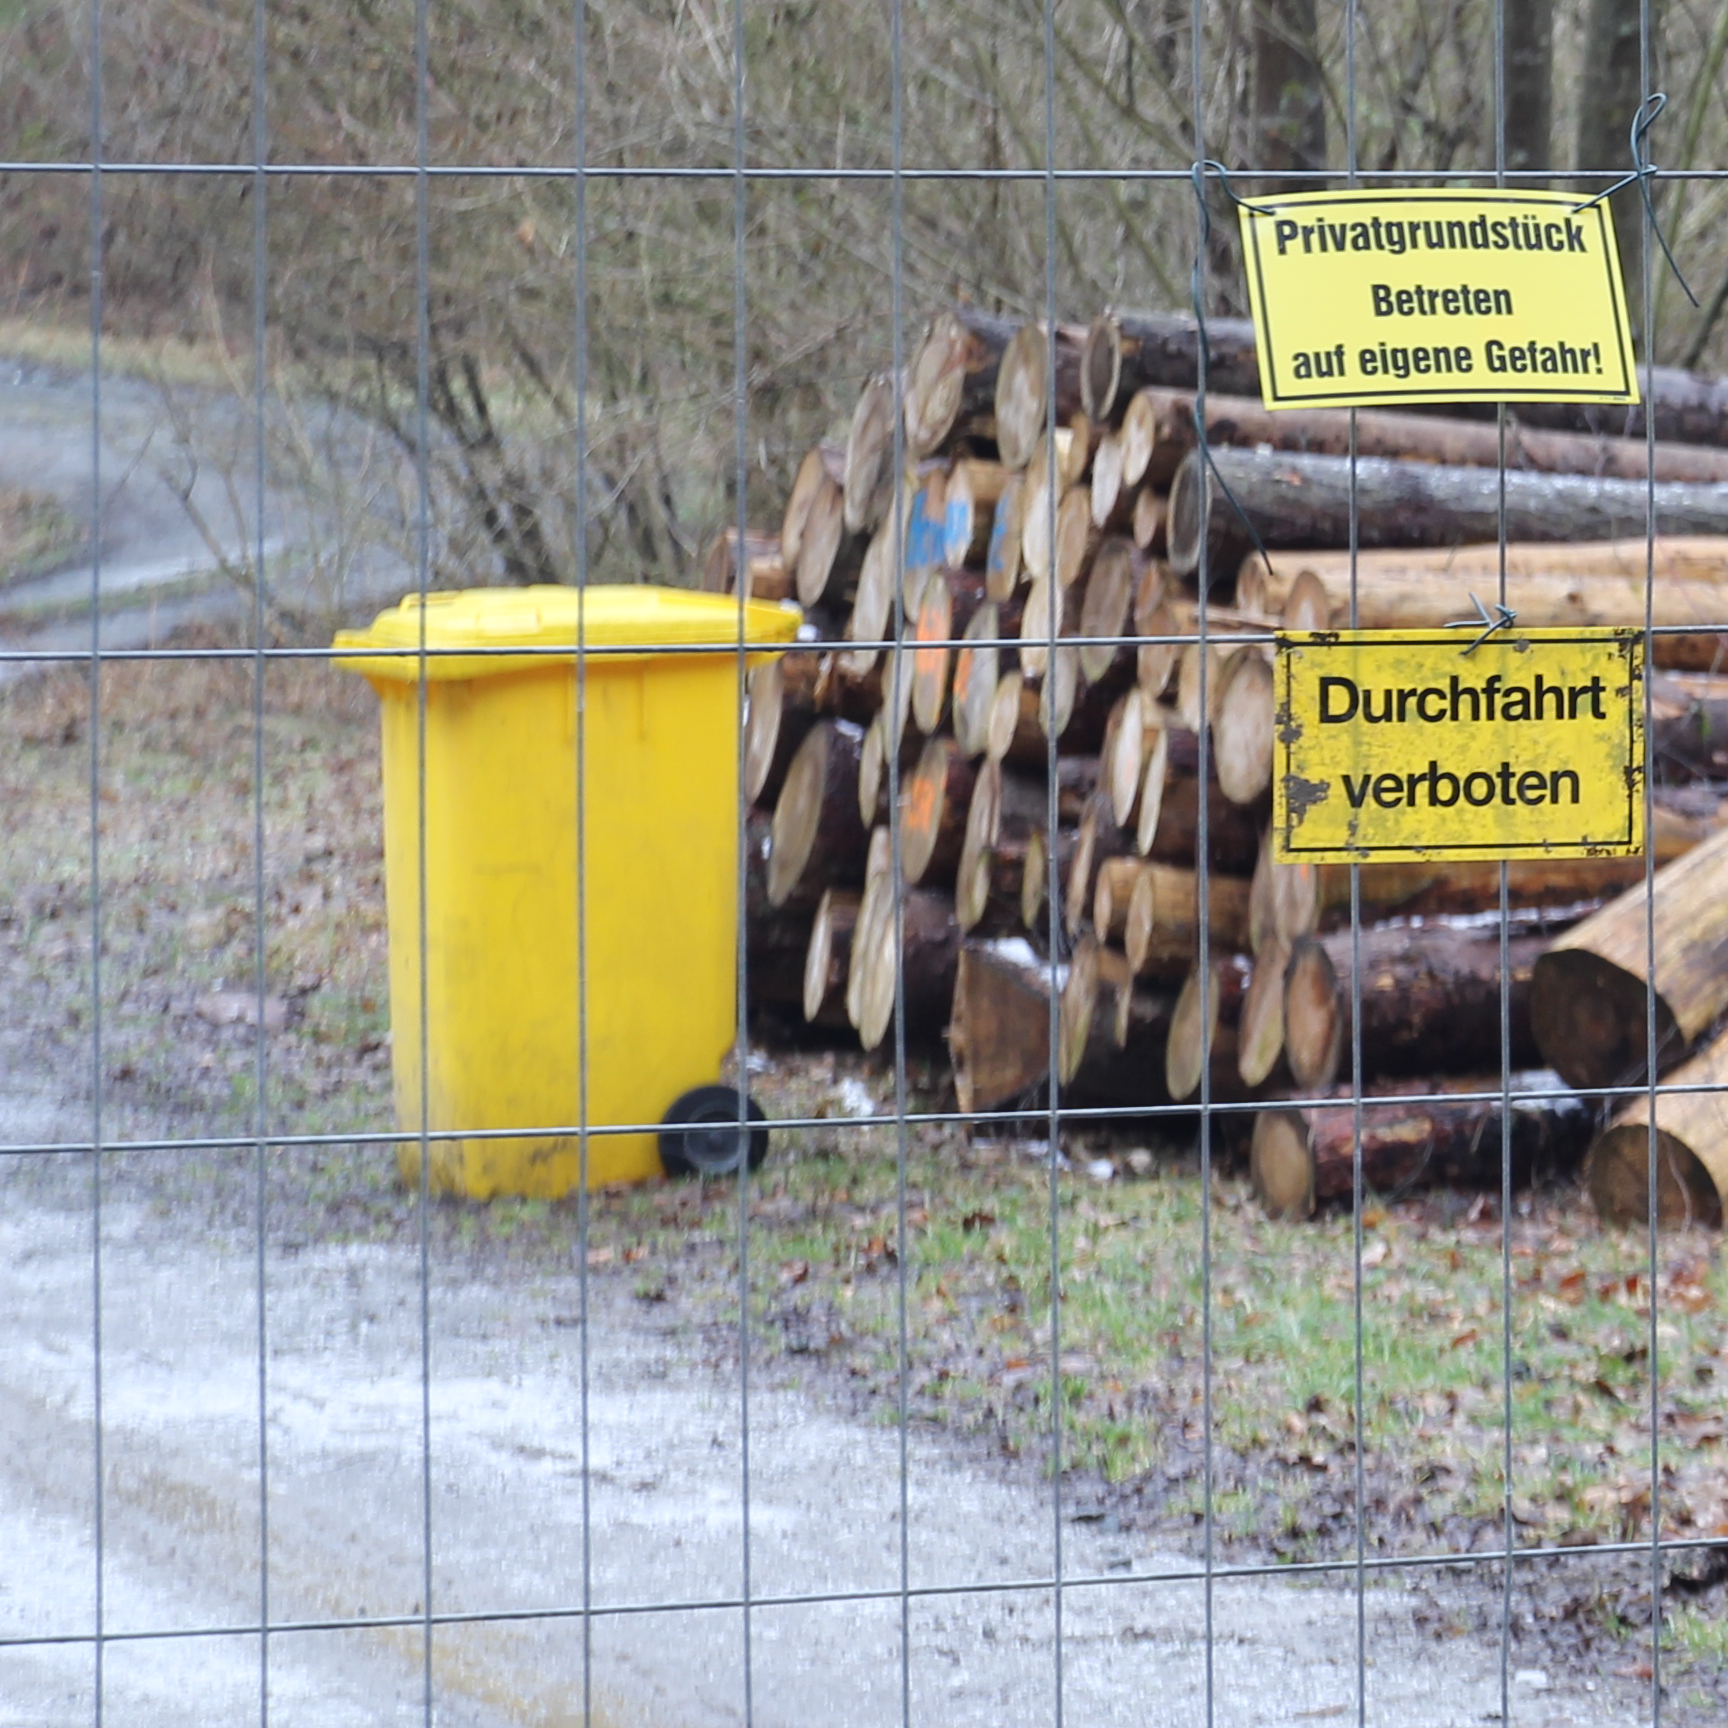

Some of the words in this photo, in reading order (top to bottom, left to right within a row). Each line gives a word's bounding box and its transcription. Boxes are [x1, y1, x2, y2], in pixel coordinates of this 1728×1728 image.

[1274, 214, 1588, 256] Privatgrundstück
[1371, 283, 1514, 317] Betreten
[1292, 344, 1345, 379] auf
[1359, 342, 1473, 379] eigene
[1485, 339, 1603, 374] Gefahr!
[1318, 674, 1607, 724] Durchfahrt
[1341, 760, 1580, 809] verboten
